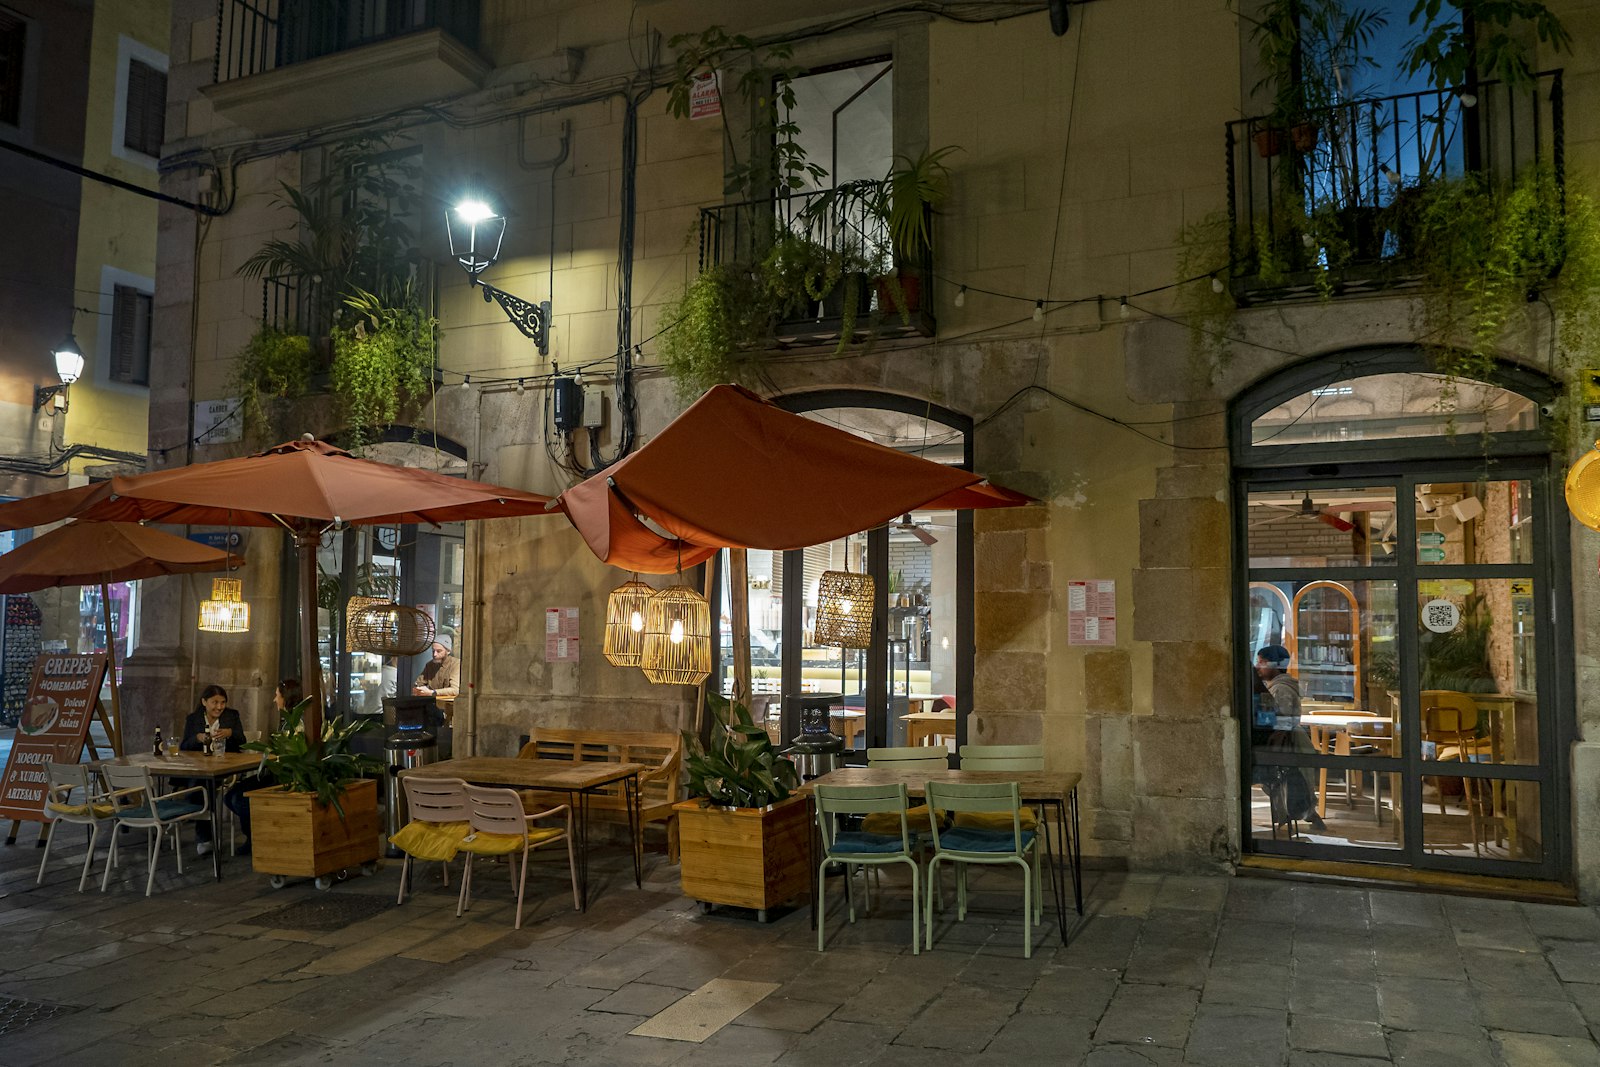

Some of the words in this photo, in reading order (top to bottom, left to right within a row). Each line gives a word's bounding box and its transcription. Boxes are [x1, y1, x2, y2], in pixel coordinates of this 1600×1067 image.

[44, 657, 94, 675] CREPES
[41, 680, 87, 691] HOMEMADE
[59, 718, 80, 729] Salats
[16, 752, 54, 765] XOCOLATA
[6, 788, 43, 801] ARTESANS
